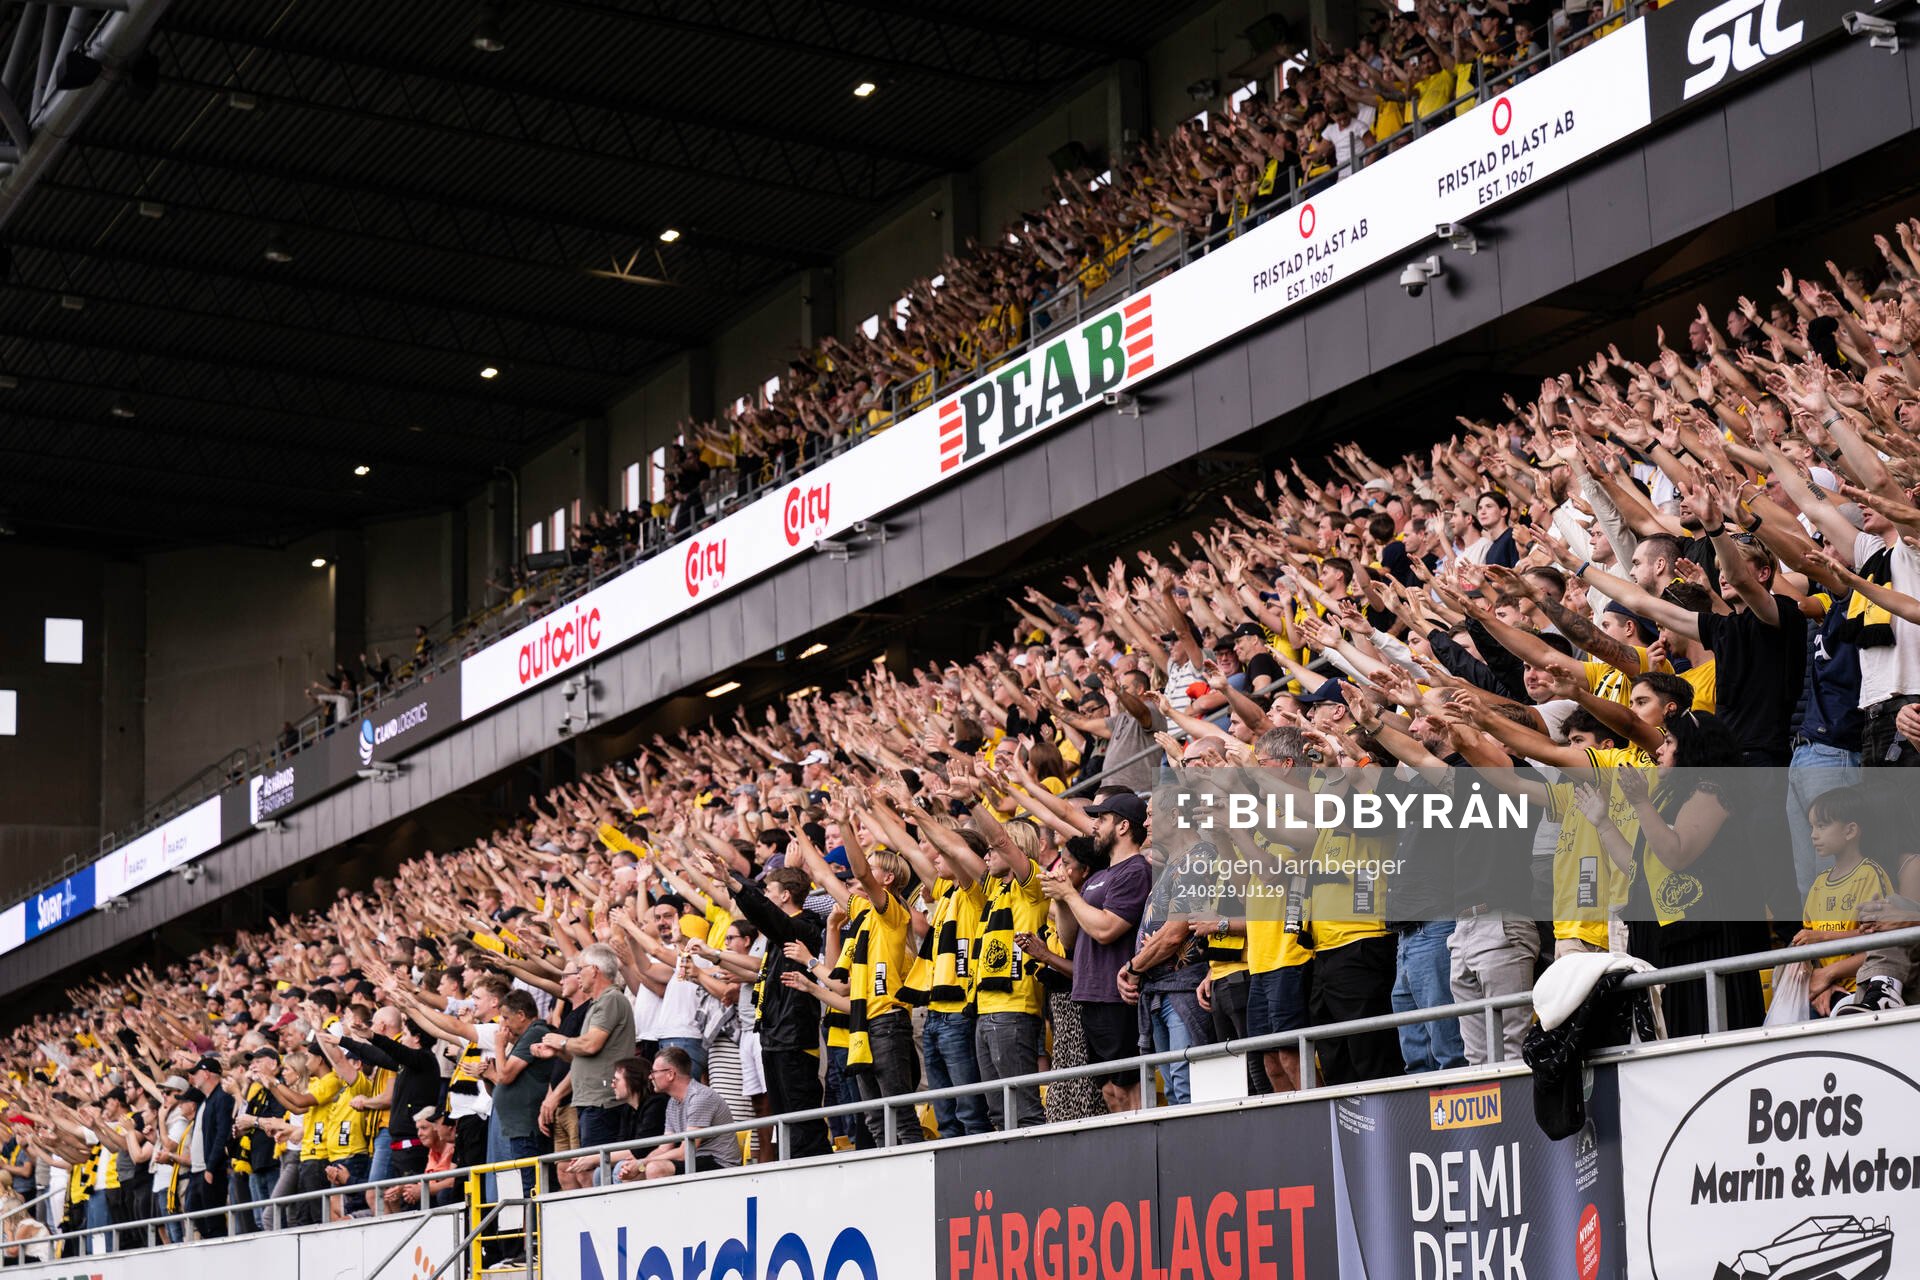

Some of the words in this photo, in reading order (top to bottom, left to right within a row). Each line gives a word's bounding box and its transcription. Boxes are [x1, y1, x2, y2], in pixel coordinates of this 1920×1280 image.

[1438, 151, 1497, 198] FRISTAD
[1501, 122, 1548, 165] PLAST
[1554, 110, 1575, 138] AB
[1478, 179, 1503, 205] EST.
[1505, 161, 1534, 190] 1967
[1253, 252, 1303, 293] FRISTAD
[1306, 229, 1346, 266] PLAST
[1351, 218, 1368, 244] AB
[1287, 279, 1308, 301] EST.
[1310, 264, 1334, 290] 1967
[960, 311, 1126, 463] PEAB
[519, 605, 601, 684] autocirc
[1448, 1093, 1499, 1125] JOTUN
[1748, 1072, 1863, 1144] Borås
[1409, 1142, 1521, 1222] DEMI
[1690, 1152, 1785, 1206] Marin
[1791, 1153, 1816, 1199] &
[949, 1185, 1315, 1280] FÄRGBOLAGET
[1413, 1222, 1530, 1280] DEKK
[1579, 1212, 1597, 1245] NYHET
